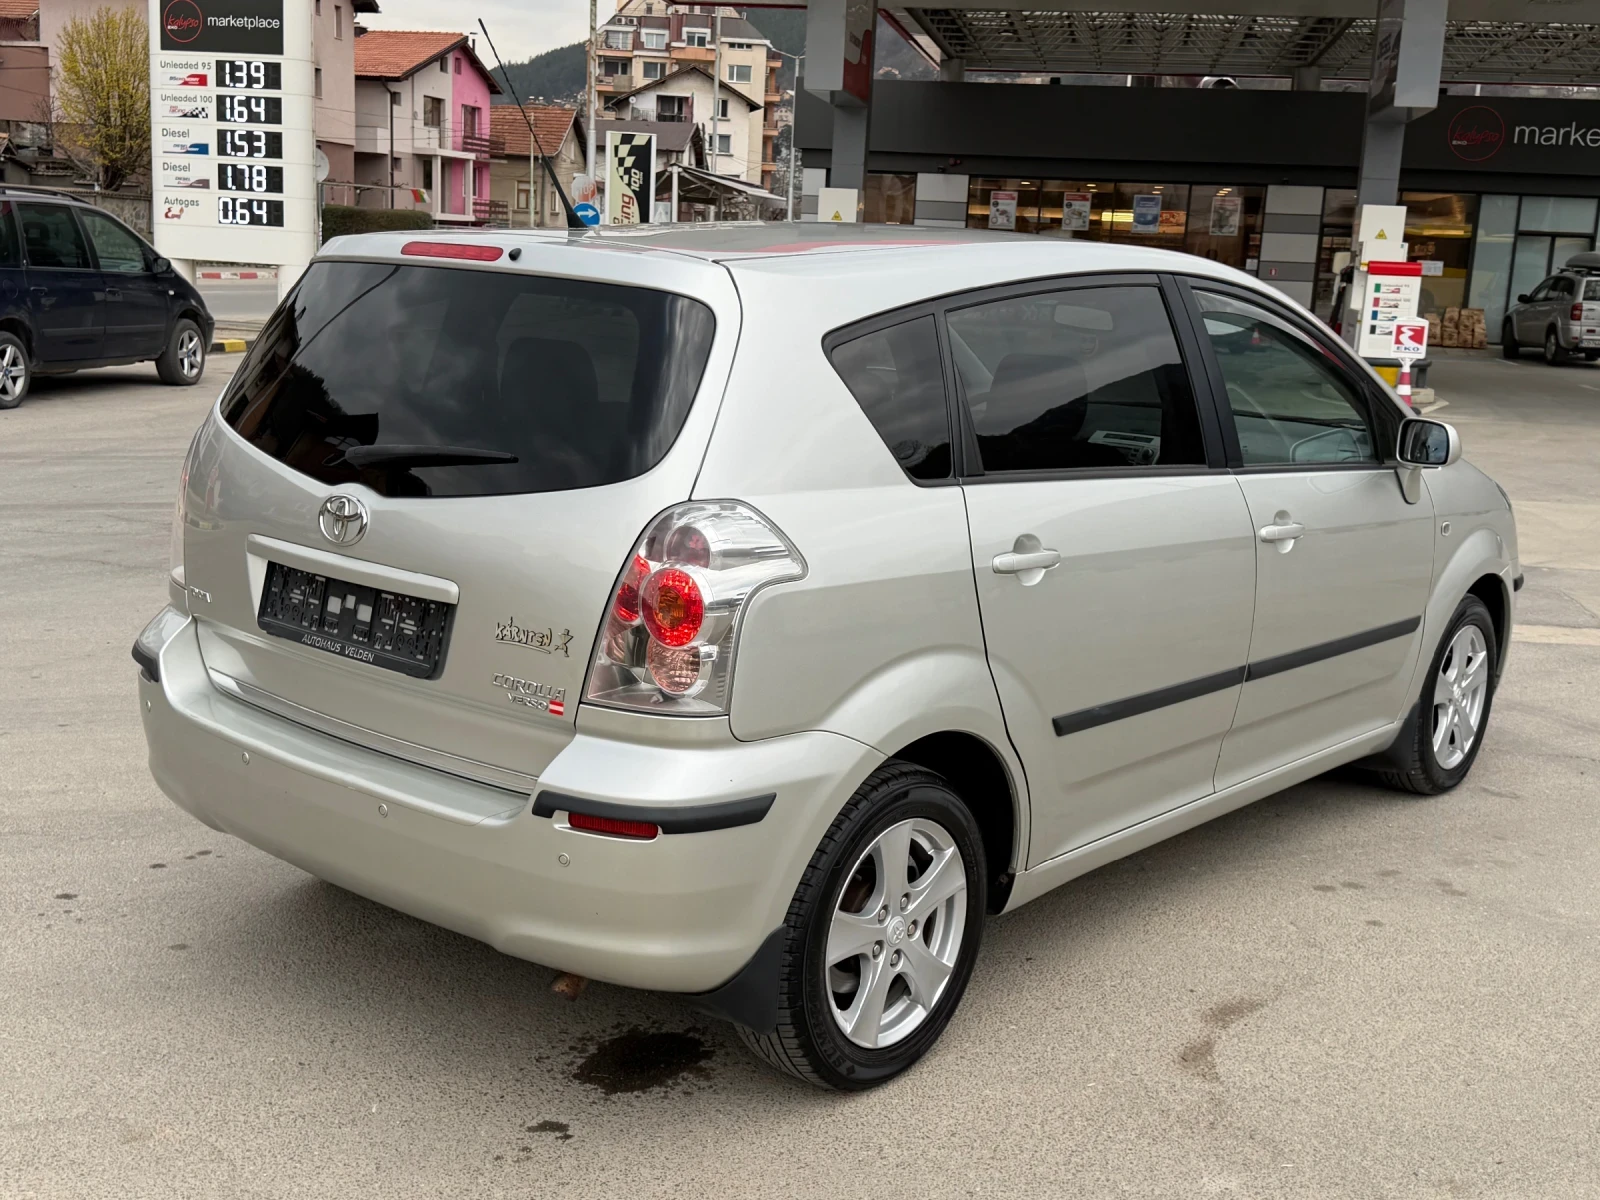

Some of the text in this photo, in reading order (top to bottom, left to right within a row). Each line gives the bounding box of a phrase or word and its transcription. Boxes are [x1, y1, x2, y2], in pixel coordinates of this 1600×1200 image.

[207, 15, 280, 30] marketplace
[160, 60, 212, 70] Unleaded 95
[225, 60, 265, 89] 1.39
[160, 94, 213, 104] Unleaded 100
[225, 95, 265, 122] 1.64
[162, 128, 190, 138] Diesel
[226, 130, 266, 158] 1.53
[1513, 121, 1600, 147] marke
[162, 162, 191, 172] Diesel
[227, 164, 266, 192] 1.78
[631, 168, 640, 191] 100
[164, 197, 200, 208] Autogas
[219, 197, 266, 225] 0.64
[301, 633, 375, 662] AUTOHAUS VELDEN
[493, 672, 566, 702] COROLLA
[507, 692, 549, 711] VERSO
